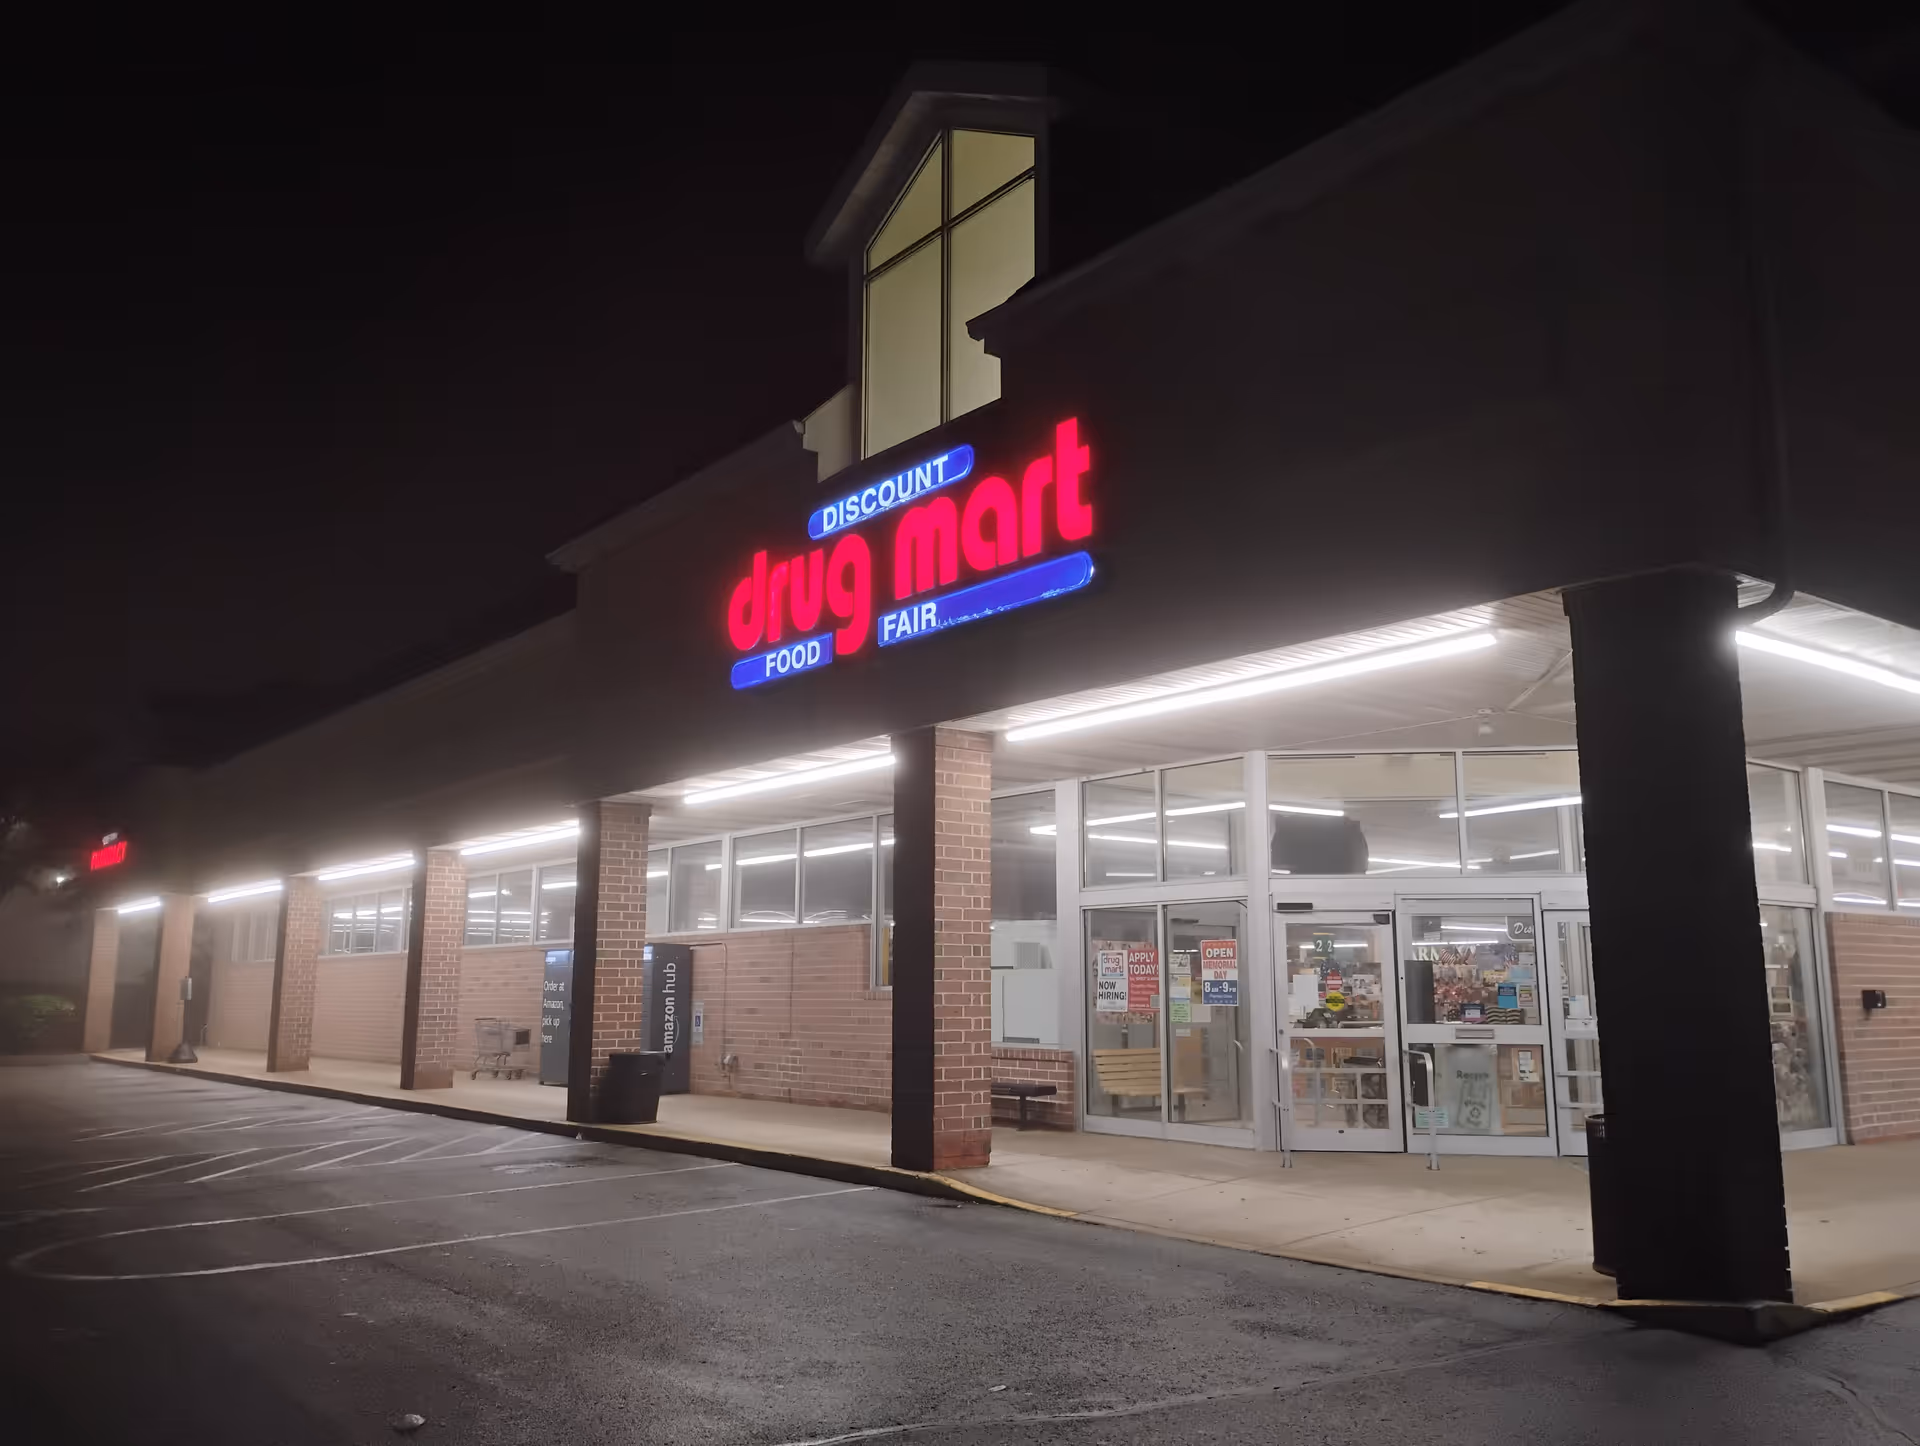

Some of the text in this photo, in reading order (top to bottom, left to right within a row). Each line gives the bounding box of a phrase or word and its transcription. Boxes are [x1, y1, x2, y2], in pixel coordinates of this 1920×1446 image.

[823, 455, 948, 532] DISCOUNT
[728, 417, 1092, 656] drug mart
[766, 602, 937, 677] FOOD FAIR
[1316, 940, 1323, 952] 2
[1129, 951, 1155, 963] APPLY
[1206, 947, 1234, 958] OPEN
[1103, 955, 1120, 966] drug
[1203, 960, 1237, 969] MEMORIAL
[1104, 965, 1124, 973] mart
[1129, 964, 1159, 975] TODAY!
[1213, 970, 1228, 980] DAY
[543, 980, 558, 992] Order
[1098, 980, 1117, 990] NOW
[1098, 991, 1127, 1001] HIRING!
[662, 962, 676, 1054] amazon hub
[542, 1014, 560, 1029] pick up
